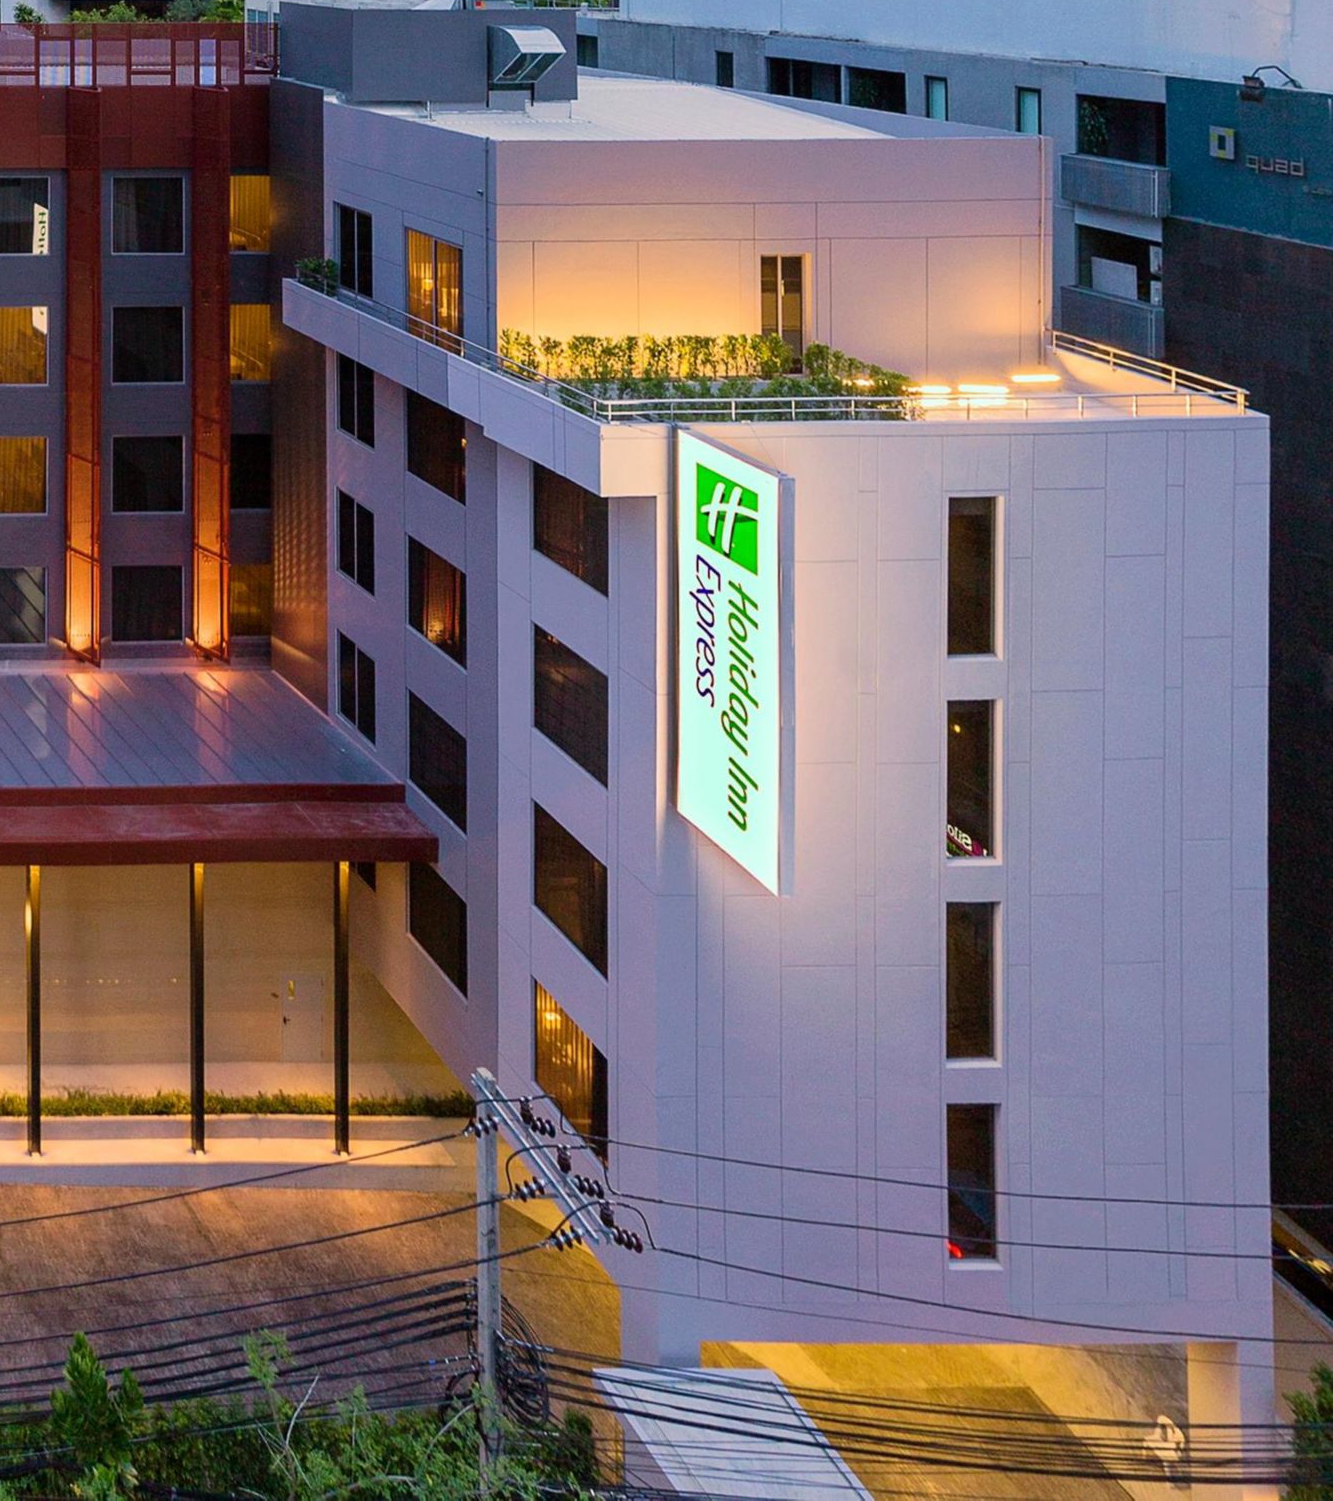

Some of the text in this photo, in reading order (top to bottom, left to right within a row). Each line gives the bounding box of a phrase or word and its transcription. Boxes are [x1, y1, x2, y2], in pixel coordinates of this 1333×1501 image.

[1246, 154, 1304, 176] quad
[689, 554, 721, 708] Express
[721, 580, 759, 832] Holiday Inn
